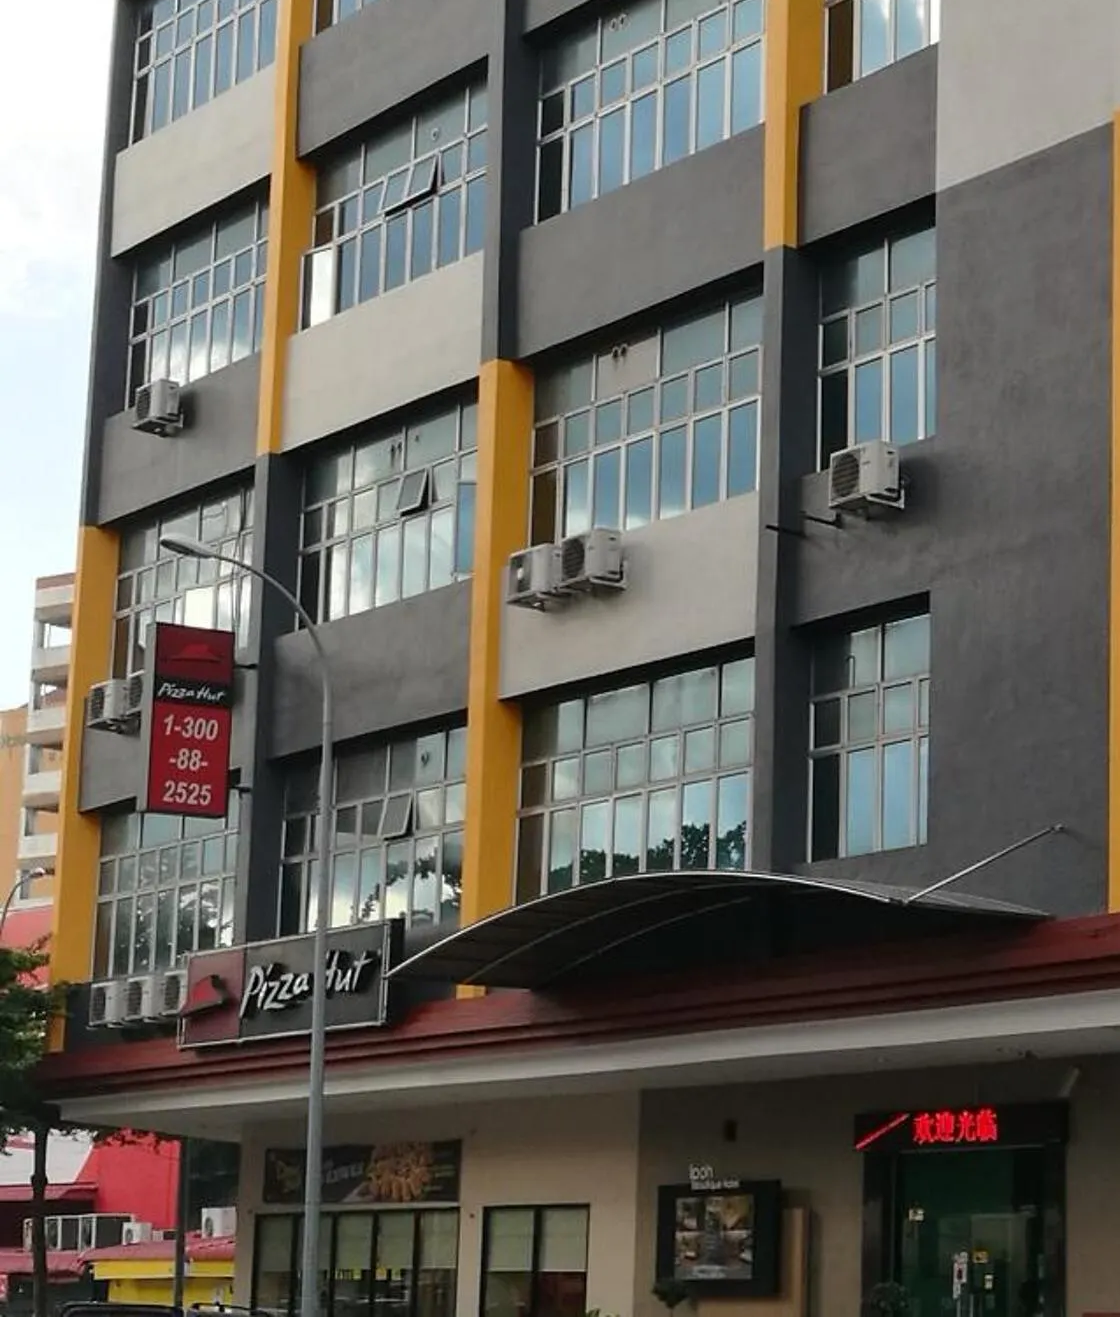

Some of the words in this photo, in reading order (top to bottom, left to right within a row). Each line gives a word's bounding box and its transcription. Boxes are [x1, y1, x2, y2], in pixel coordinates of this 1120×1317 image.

[157, 682, 194, 699] Pizza
[197, 685, 226, 702] Hut
[163, 714, 219, 741] 1-300
[169, 748, 209, 772] -88-
[163, 781, 212, 806] 2525
[239, 963, 310, 1018] Pizza
[913, 1108, 998, 1145] 欢迎光临
